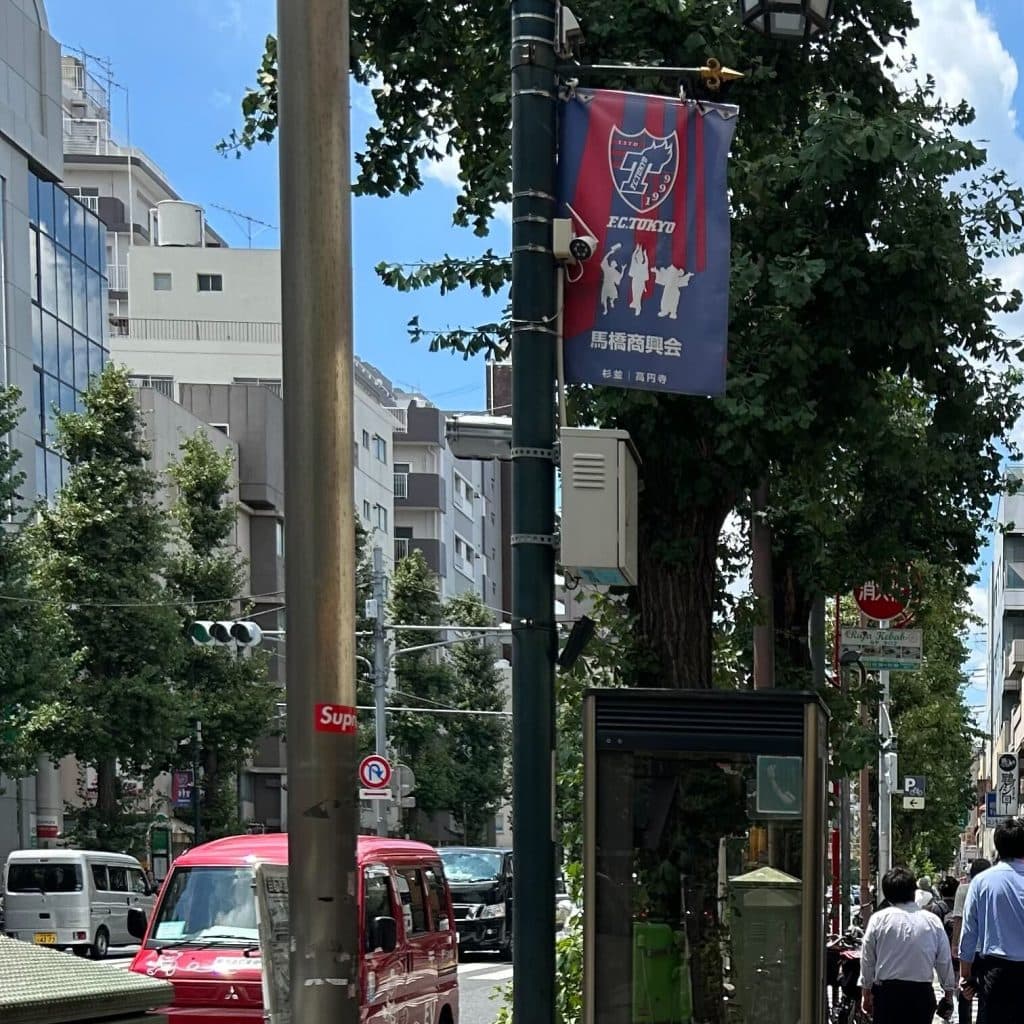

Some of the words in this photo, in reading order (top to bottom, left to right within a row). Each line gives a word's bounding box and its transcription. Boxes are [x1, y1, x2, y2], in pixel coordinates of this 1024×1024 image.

[644, 174, 671, 206] 1999
[590, 330, 683, 357] 馬橋商興会
[602, 368, 623, 380] 杉並
[635, 371, 667, 385] 高円寺
[905, 778, 916, 792] P
